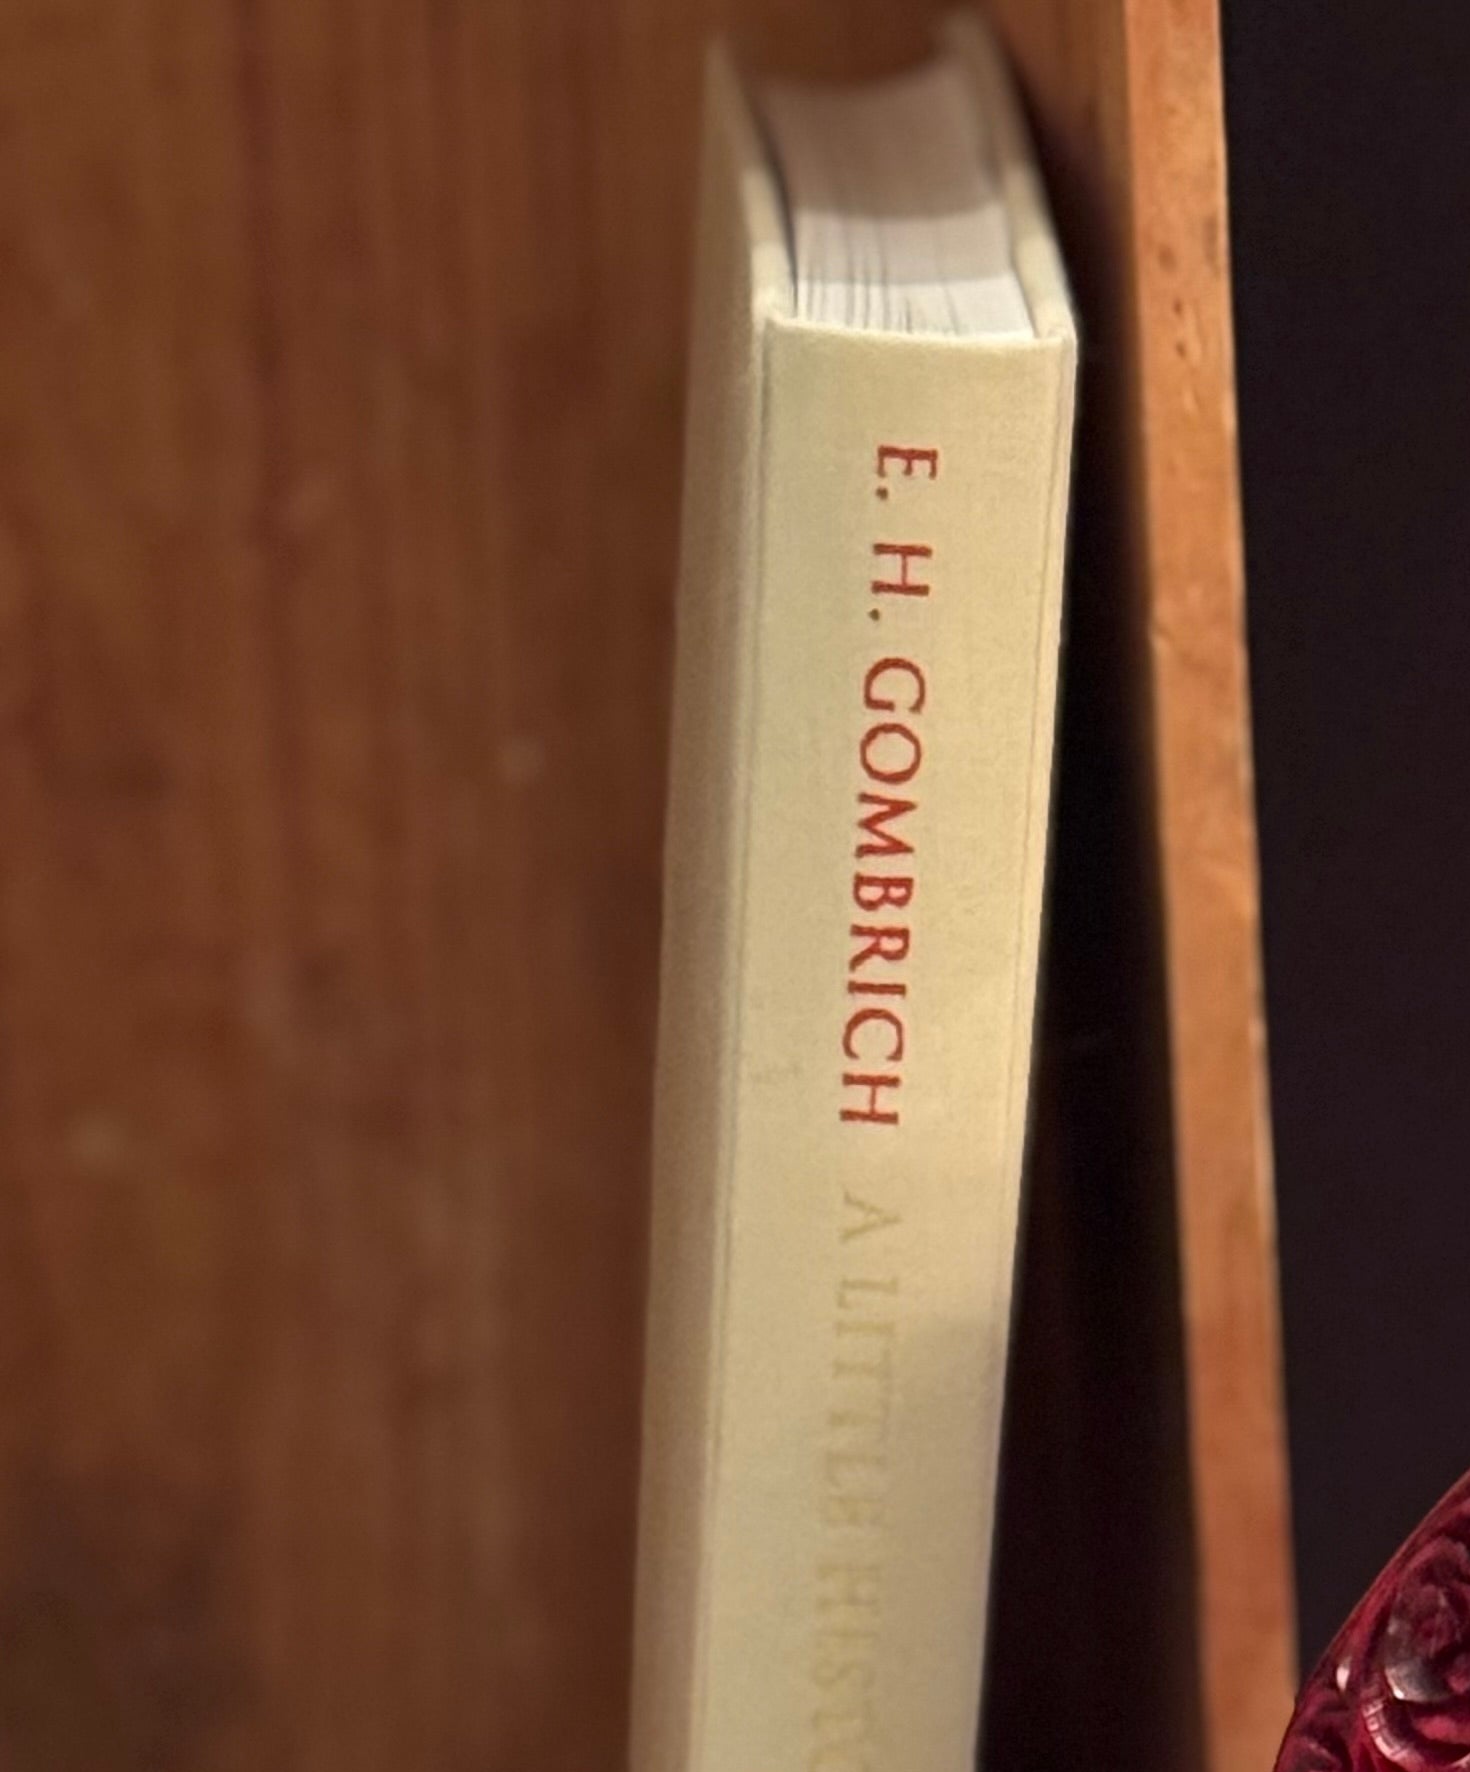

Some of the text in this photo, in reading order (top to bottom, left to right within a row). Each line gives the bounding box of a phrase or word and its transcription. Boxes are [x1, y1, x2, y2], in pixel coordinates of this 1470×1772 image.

[838, 444, 940, 1127] E. H. GOMBRICH
[837, 1189, 903, 1246] A
[817, 1277, 899, 1529] LITTLE
